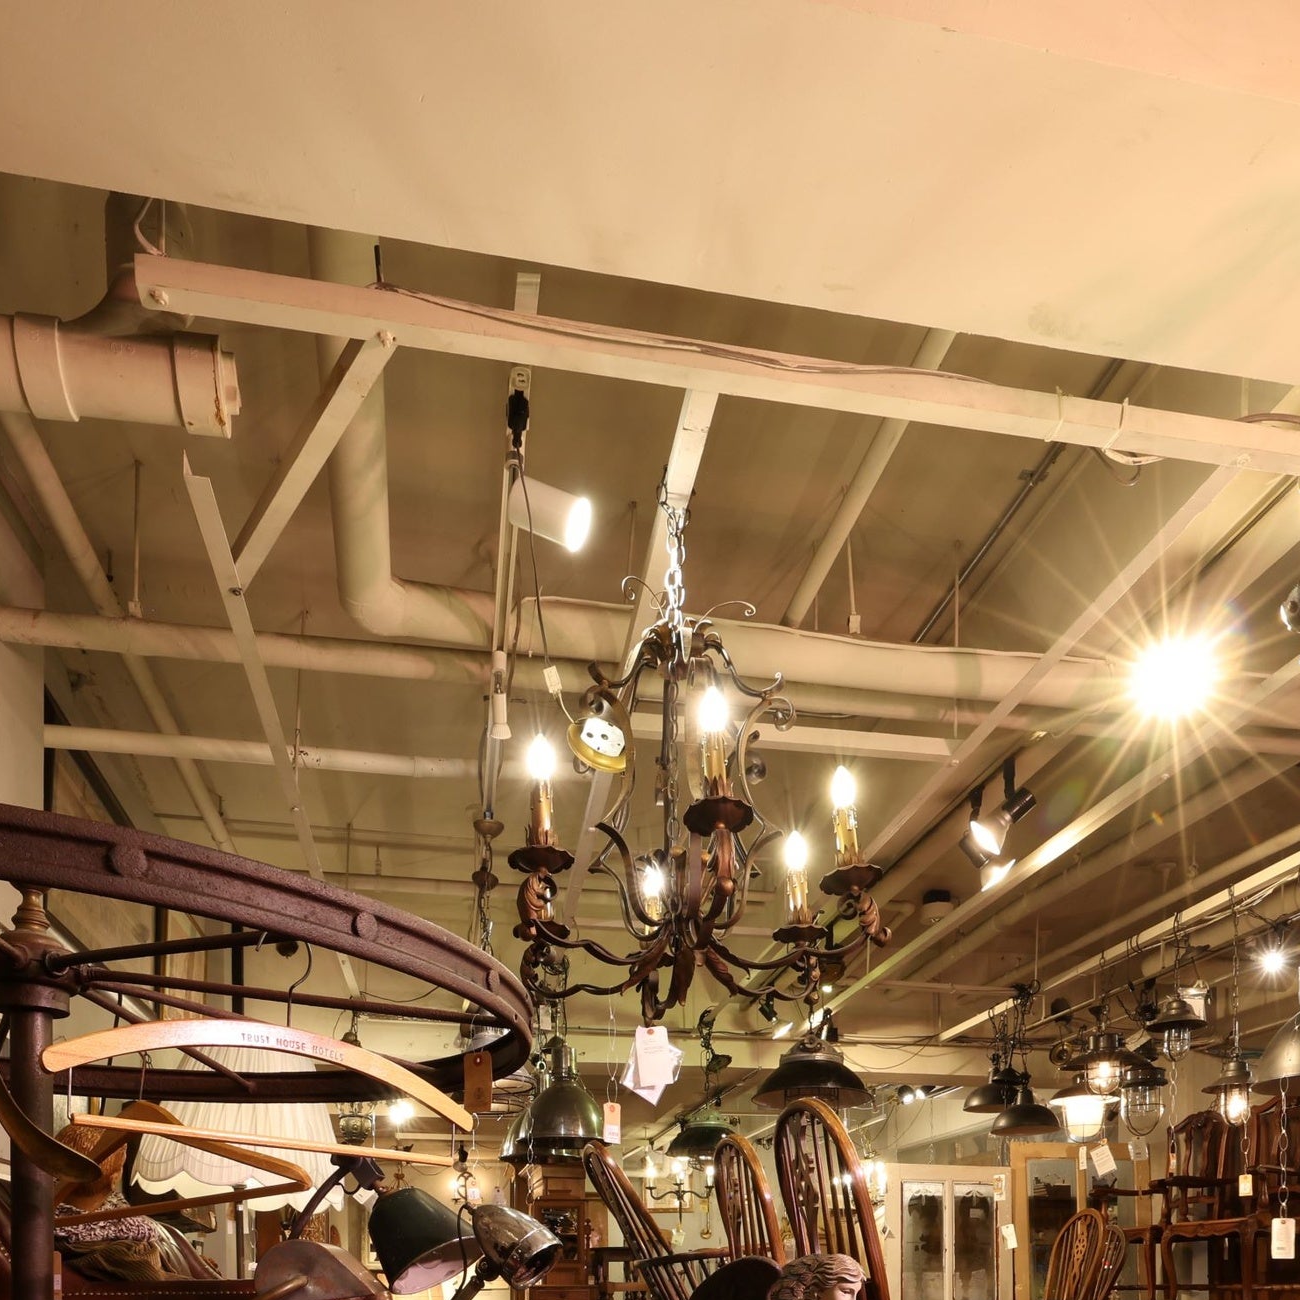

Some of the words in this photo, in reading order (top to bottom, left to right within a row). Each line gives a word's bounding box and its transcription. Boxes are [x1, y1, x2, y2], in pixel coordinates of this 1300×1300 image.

[241, 1032, 269, 1044] TRUST
[276, 1037, 306, 1052] HOUSE
[312, 1045, 344, 1062] HOTELS
